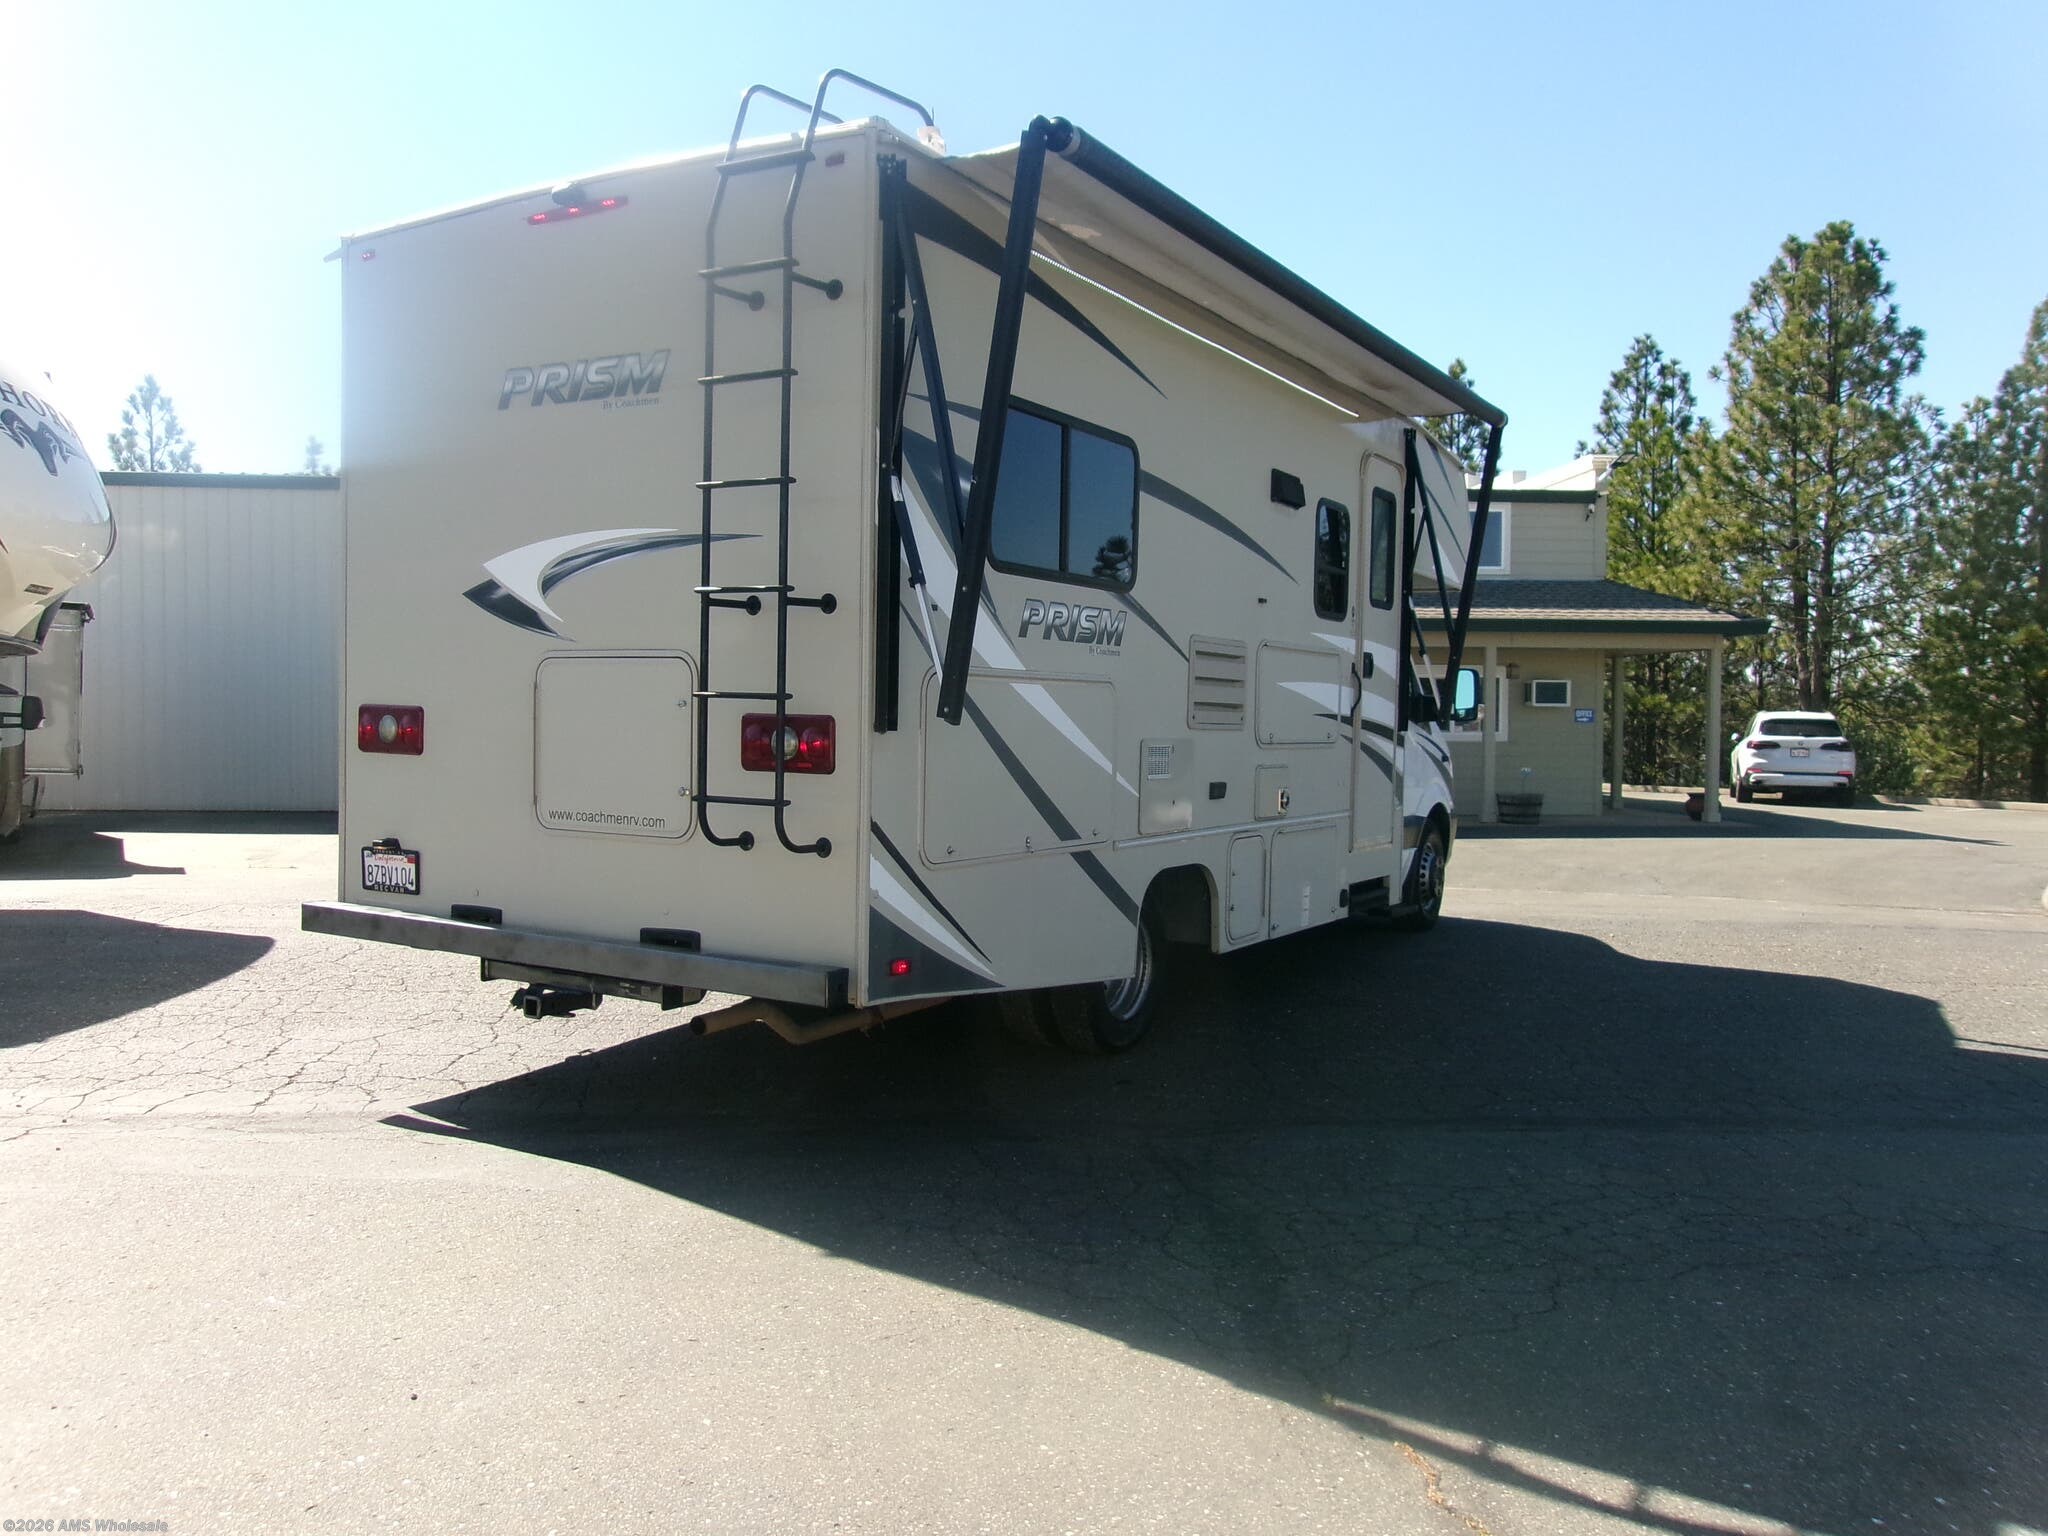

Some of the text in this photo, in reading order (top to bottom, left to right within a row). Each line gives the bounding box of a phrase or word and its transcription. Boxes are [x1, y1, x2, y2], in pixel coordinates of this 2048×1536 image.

[498, 349, 671, 410] PRISM
[1018, 598, 1127, 646] PRISM
[548, 809, 666, 828] www.coachmenrv.com
[367, 864, 414, 887] 8ZBV104
